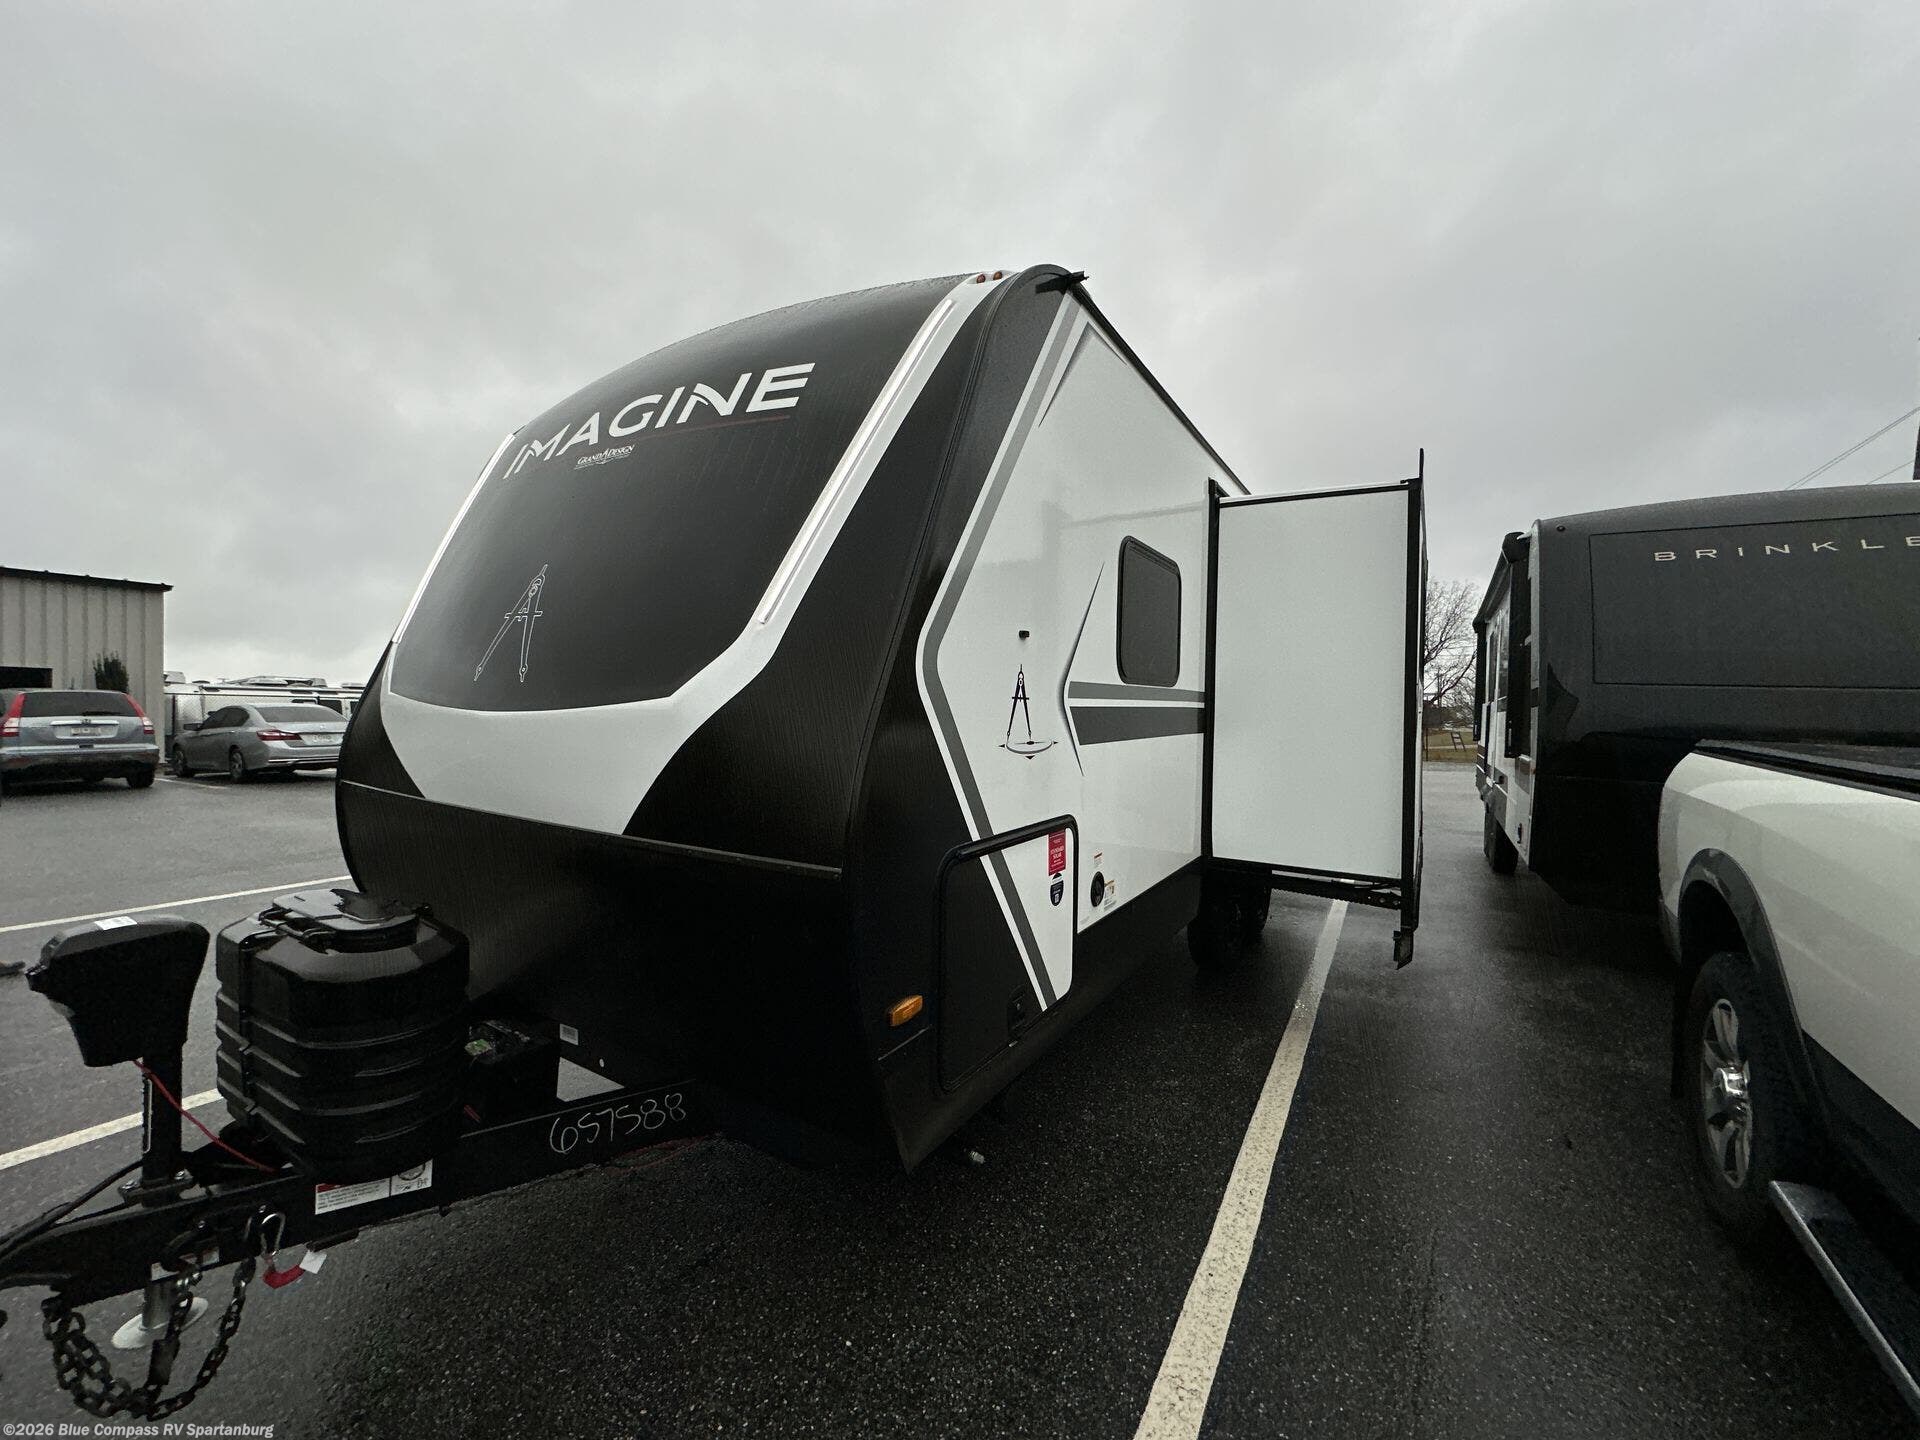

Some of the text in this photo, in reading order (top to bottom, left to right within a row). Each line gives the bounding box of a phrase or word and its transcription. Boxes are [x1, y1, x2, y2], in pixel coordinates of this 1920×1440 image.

[503, 362, 816, 480] IMAGINE
[1654, 536, 1920, 561] BRINKLE
[549, 1092, 686, 1154] 657588
